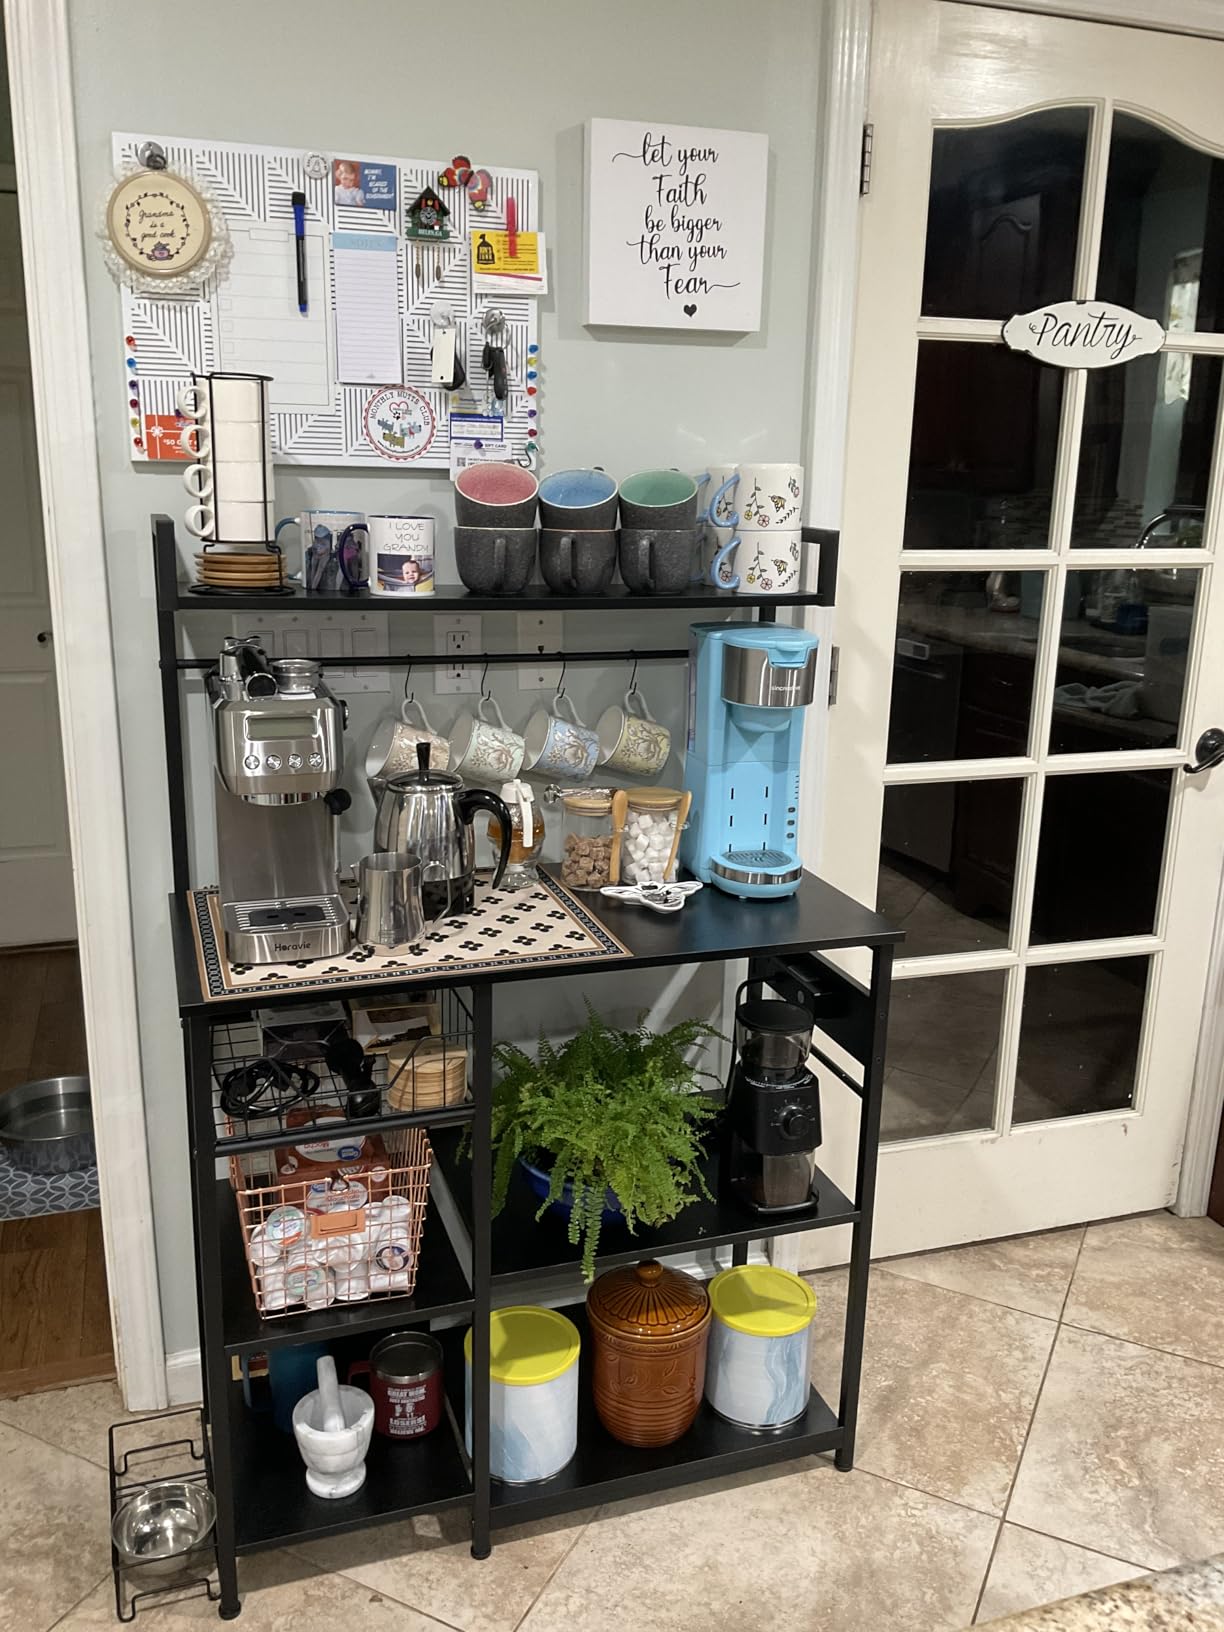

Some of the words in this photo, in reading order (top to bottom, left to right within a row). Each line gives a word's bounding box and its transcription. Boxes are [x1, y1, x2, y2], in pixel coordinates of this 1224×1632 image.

[612, 132, 673, 167] let
[677, 147, 719, 176] your
[652, 173, 707, 207] Faith
[644, 205, 666, 234] be
[670, 204, 722, 243] bigger
[626, 233, 683, 265] than
[688, 244, 727, 272] your
[659, 263, 741, 300] Fear
[1029, 311, 1143, 360] Pantry
[369, 391, 394, 420] MONTHLY
[419, 405, 430, 426] CLUB
[395, 522, 425, 531] LOVE
[395, 533, 420, 543] YOU
